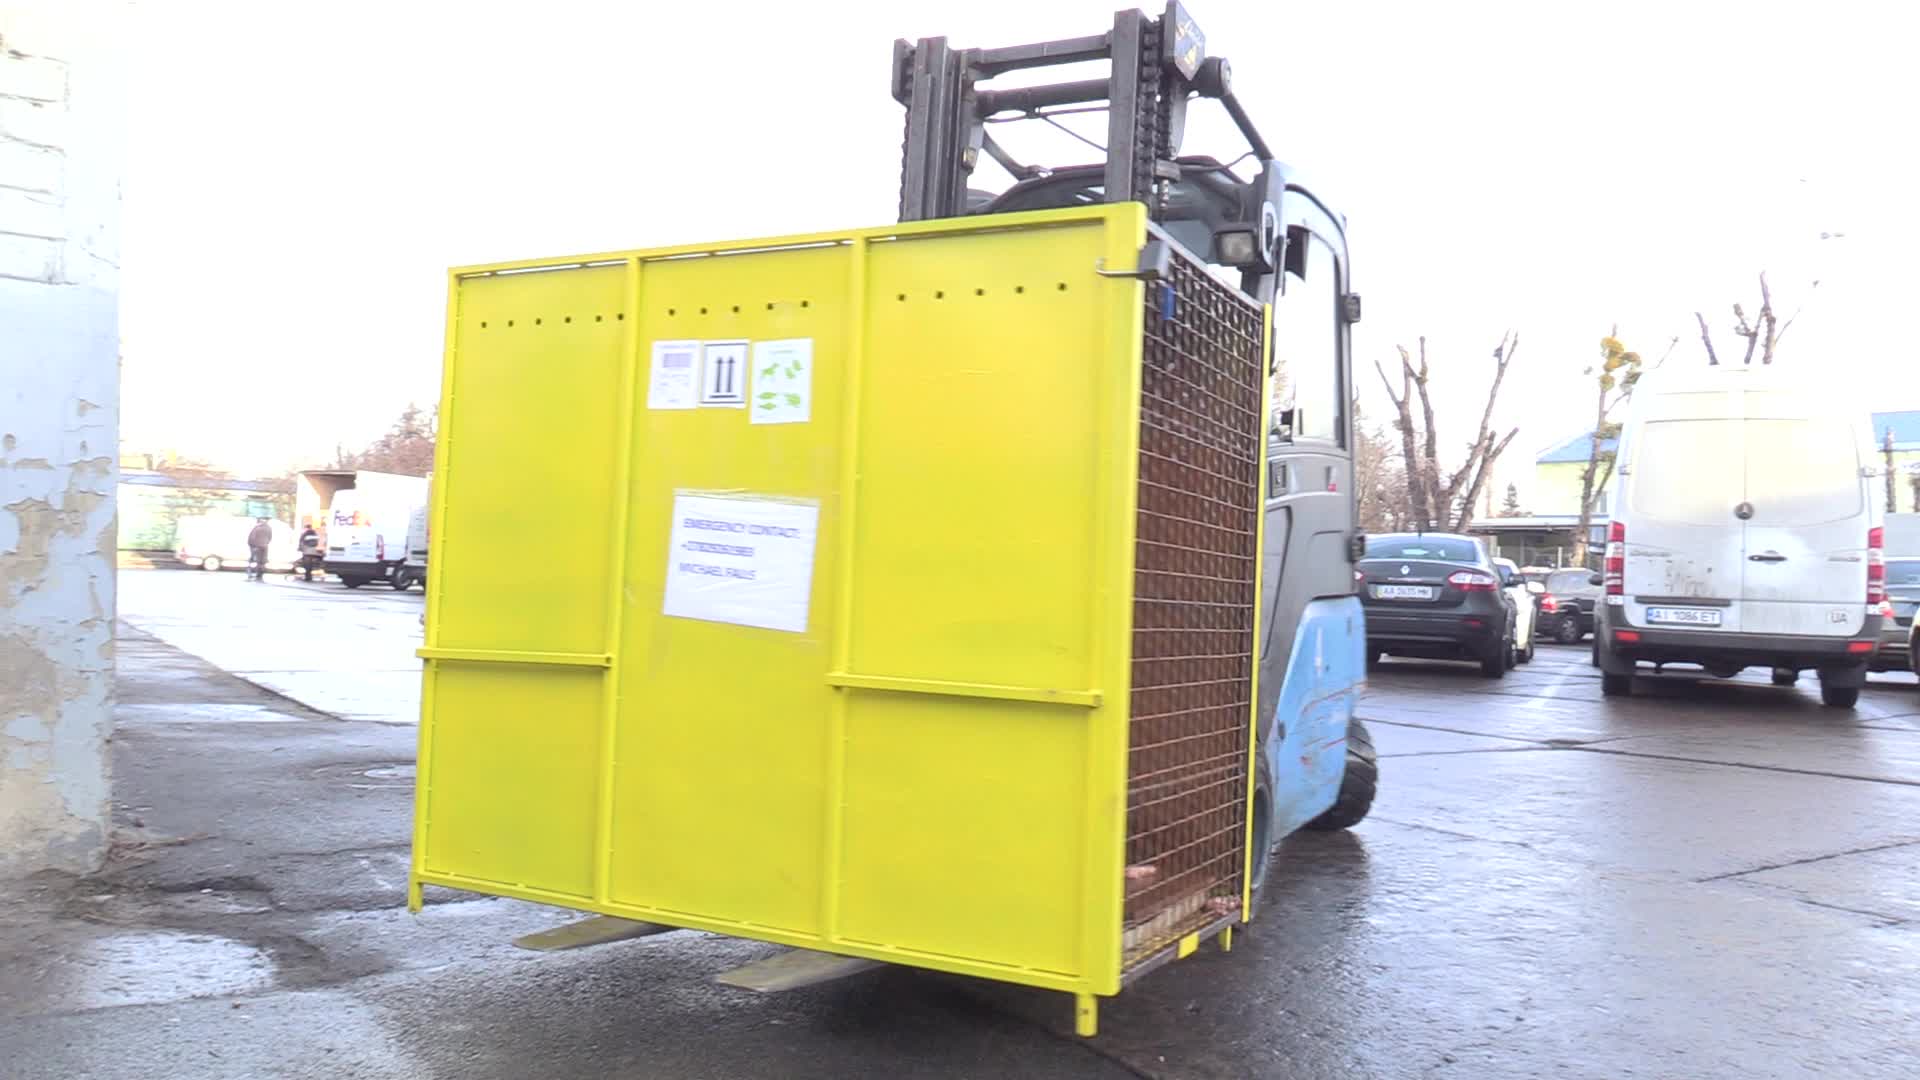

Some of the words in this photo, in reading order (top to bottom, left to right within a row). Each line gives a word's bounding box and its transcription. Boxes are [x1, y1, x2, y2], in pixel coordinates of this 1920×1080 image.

[333, 509, 373, 528] FedEx
[682, 517, 746, 534] EMERGENCY
[1831, 612, 1848, 624] UA
